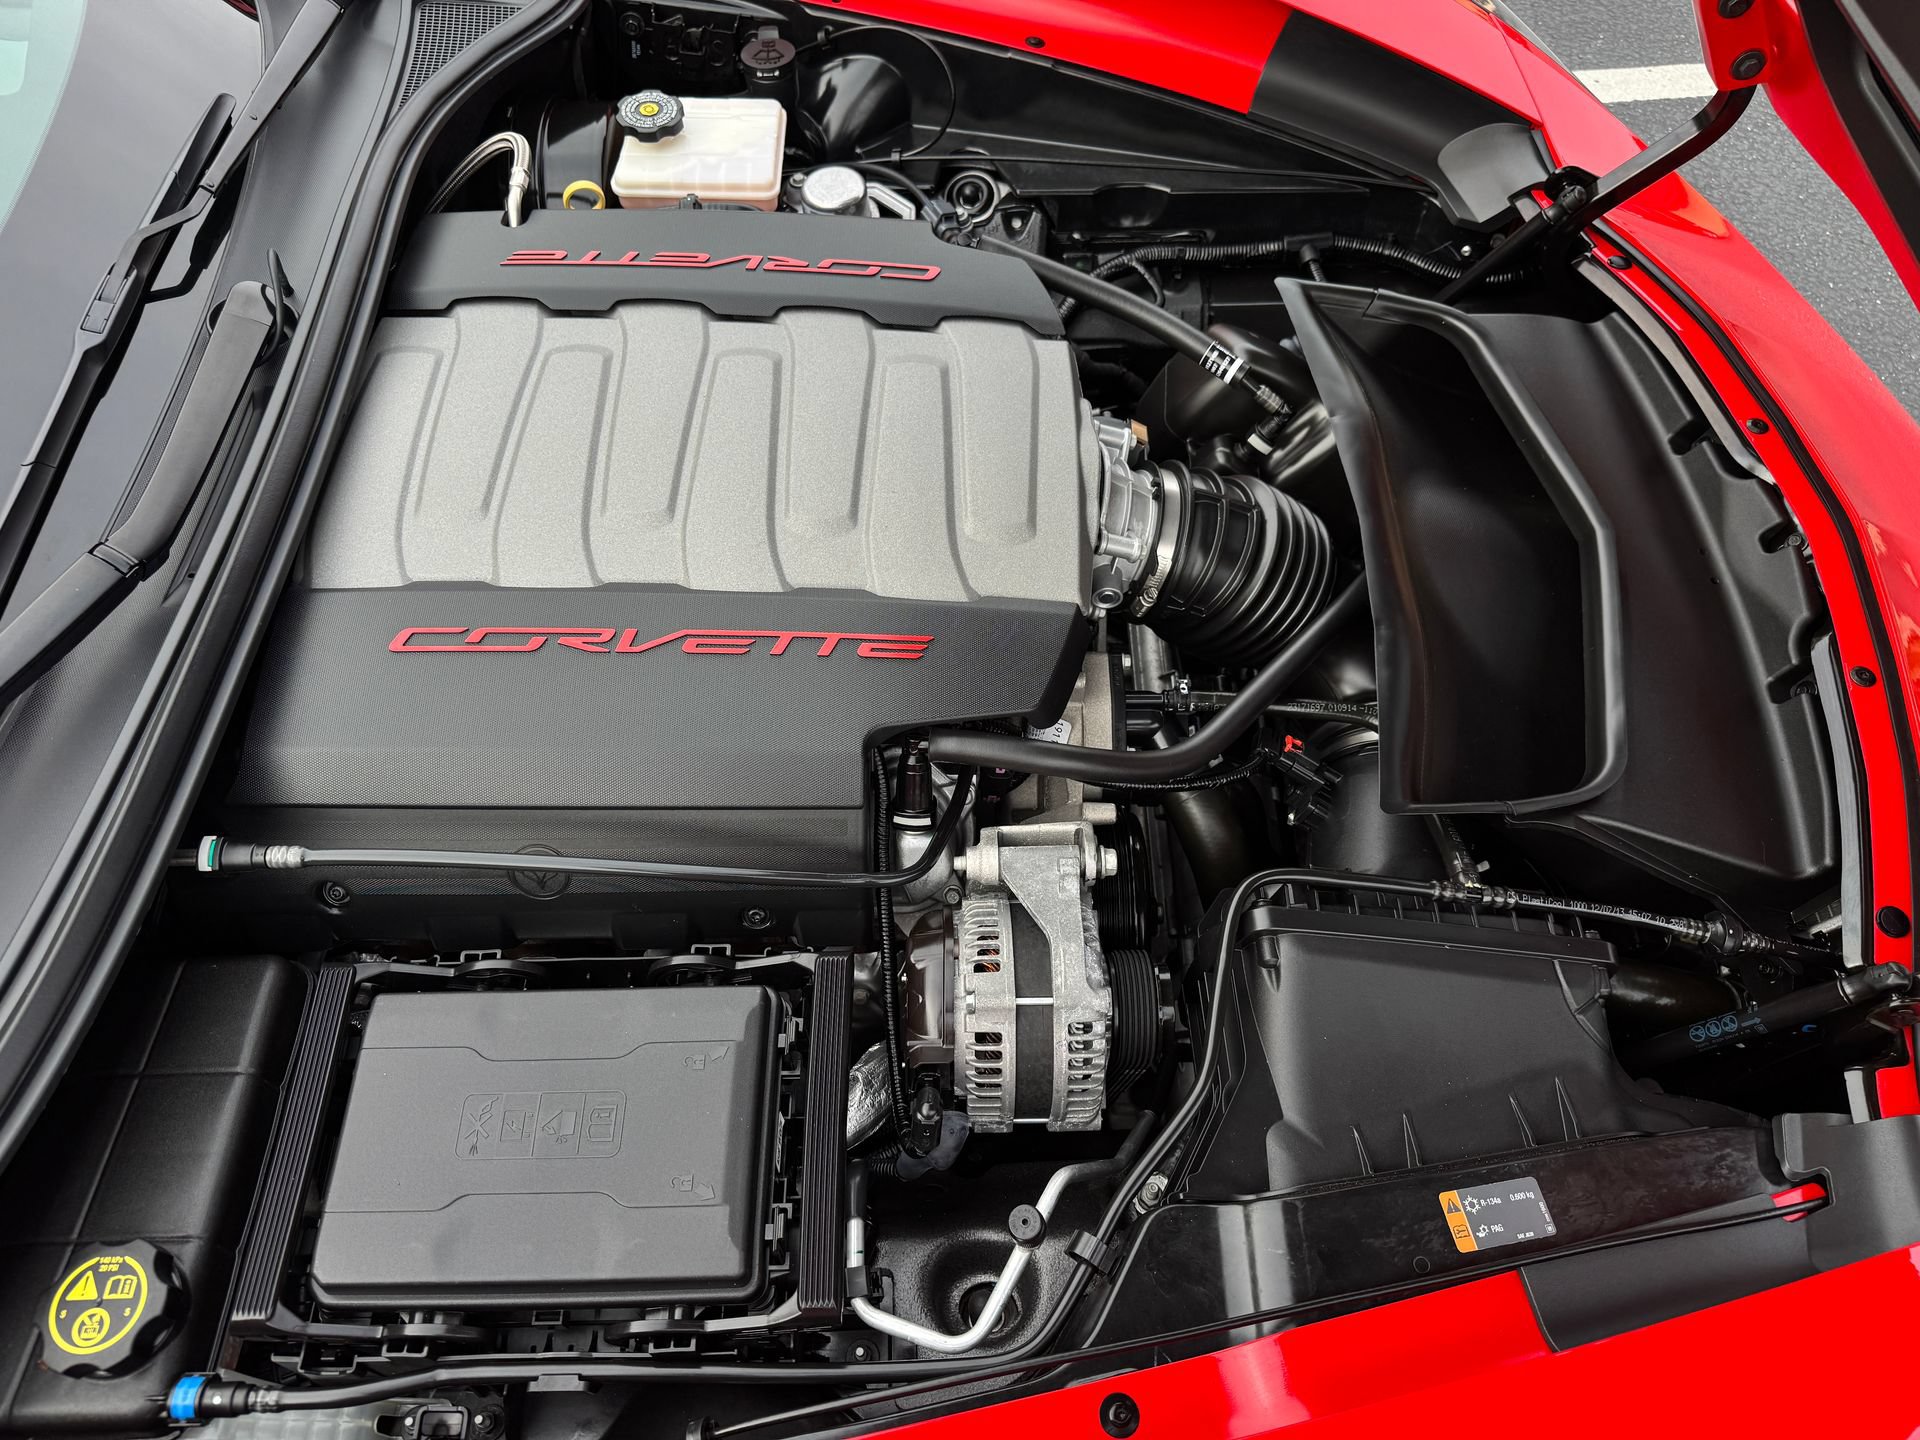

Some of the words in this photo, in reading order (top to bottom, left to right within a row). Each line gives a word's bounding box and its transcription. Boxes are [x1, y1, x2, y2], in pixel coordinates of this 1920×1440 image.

[499, 249, 942, 281] CORVETTE
[389, 627, 936, 659] CORVETTE
[1480, 1197, 1502, 1207] R-134a
[1490, 1223, 1504, 1233] PAG
